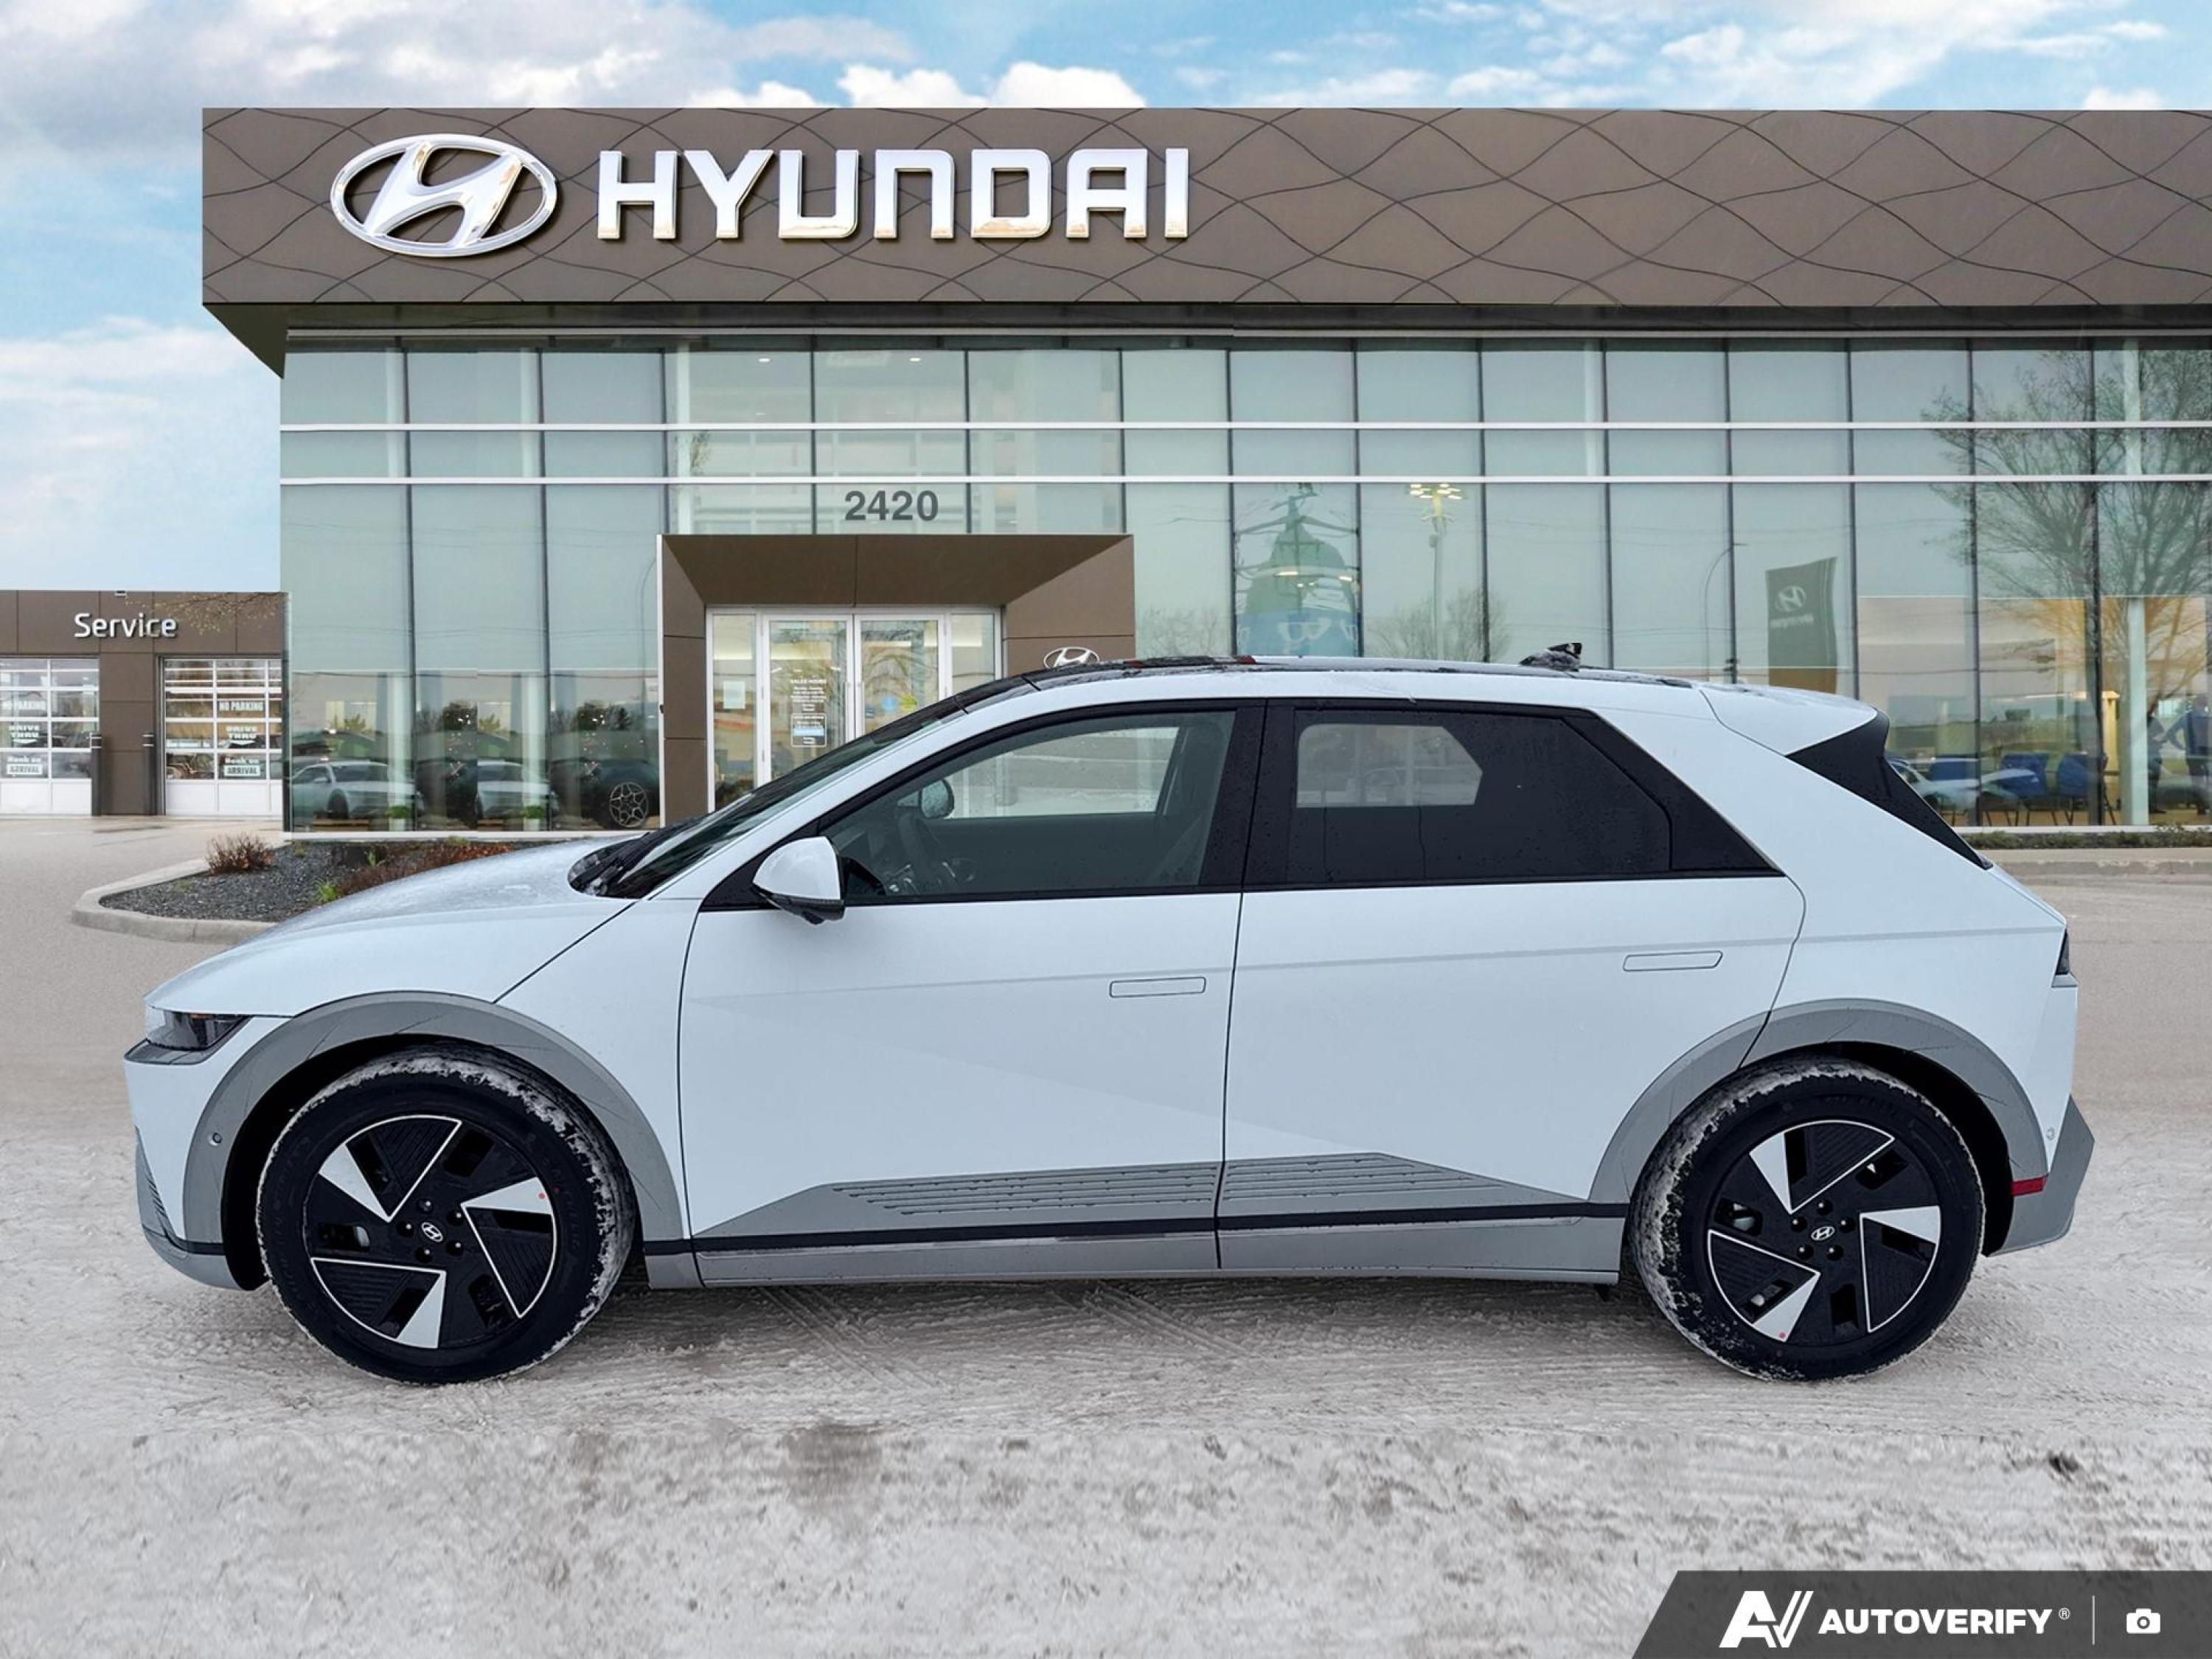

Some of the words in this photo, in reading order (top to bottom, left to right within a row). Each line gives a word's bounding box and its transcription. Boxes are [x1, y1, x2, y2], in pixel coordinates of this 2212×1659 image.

[597, 148, 1189, 240] HYUNDAI
[844, 490, 939, 521] 2420
[74, 613, 177, 638] Service
